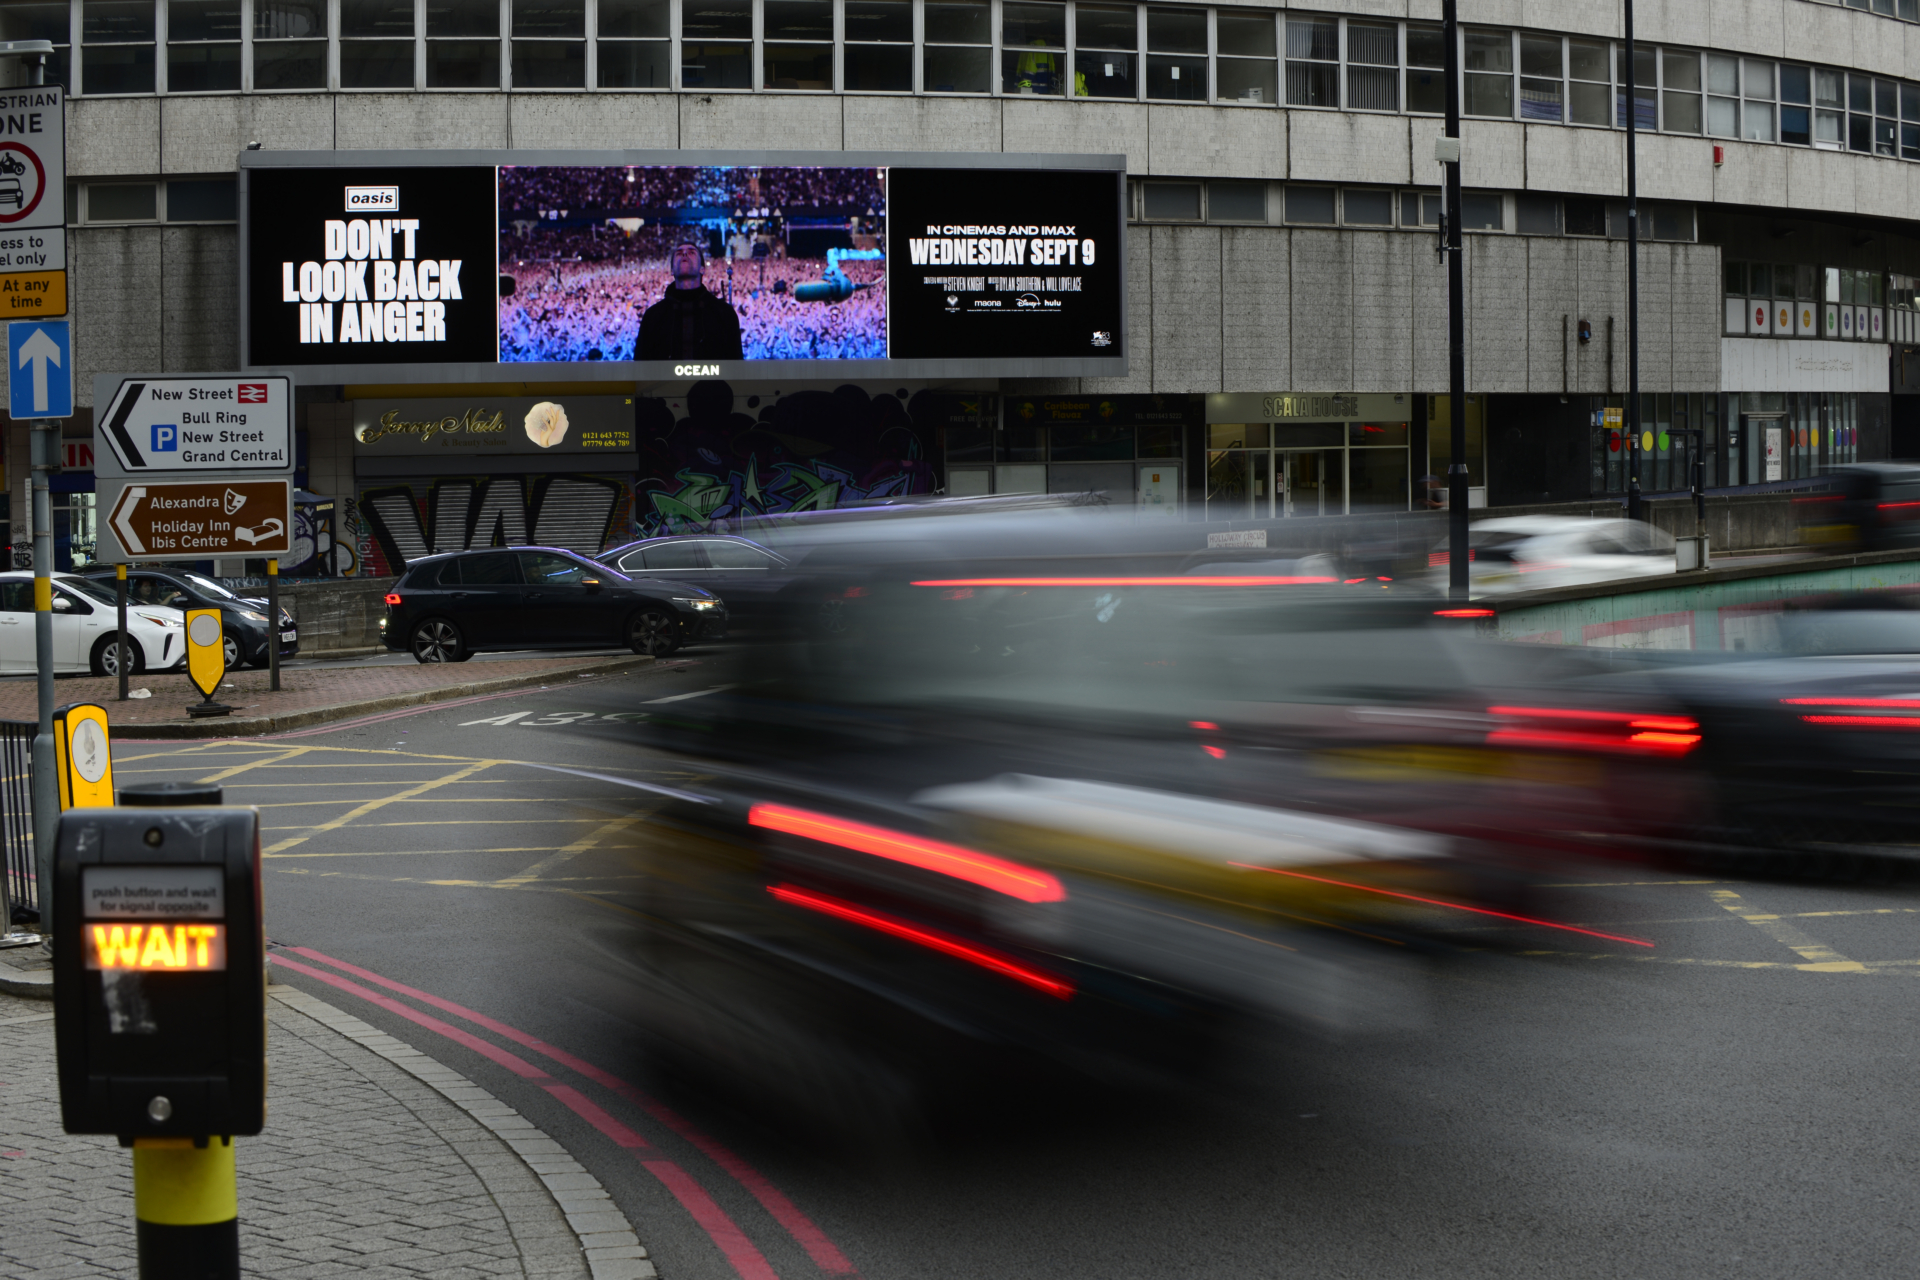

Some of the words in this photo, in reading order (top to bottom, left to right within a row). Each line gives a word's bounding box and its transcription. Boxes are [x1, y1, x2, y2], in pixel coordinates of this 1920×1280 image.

[0, 113, 43, 135] NE
[350, 190, 394, 206] oasis
[926, 225, 941, 236] IN
[943, 225, 1006, 236] CINEMAS
[1008, 225, 1039, 236] AND
[1041, 225, 1076, 236] IMAX
[29, 235, 44, 249] to
[324, 219, 420, 260] DON'T
[909, 238, 1027, 266] WEDNESDAY
[1030, 238, 1078, 266] SEPT
[1081, 238, 1096, 266] 9
[16, 251, 47, 269] only
[2, 279, 23, 293] At
[24, 280, 50, 295] any
[282, 260, 369, 302] LOOK
[373, 259, 463, 301] BACK
[10, 295, 43, 309] time
[1044, 299, 1062, 307] hulu
[300, 303, 333, 343] IN
[339, 301, 446, 343] ANGER
[674, 365, 720, 377] OCEAN
[151, 389, 183, 401] New
[188, 387, 233, 400] Street
[1044, 401, 1090, 411] Caribbean
[1263, 396, 1309, 418] SCALA
[1312, 396, 1359, 418] HOUSE
[183, 411, 210, 424] Bull
[215, 411, 247, 426] Ring
[949, 415, 966, 423] FREE
[1052, 410, 1082, 419] Flavaz
[361, 408, 441, 445] Jenny
[440, 407, 507, 435] Nails
[156, 427, 174, 450] P
[183, 431, 213, 443] New
[219, 430, 264, 442] Street
[582, 432, 598, 440] 0121
[599, 432, 612, 440] 643
[613, 431, 630, 439] 7752
[452, 438, 481, 449] Beauty
[483, 437, 507, 447] Salon
[582, 440, 603, 448] 07779
[604, 440, 617, 448] 656
[617, 440, 630, 448] 789
[183, 450, 225, 463] Grand
[230, 449, 283, 462] Central
[150, 496, 220, 510] Alexandra
[152, 521, 204, 535] Holiday
[209, 520, 231, 532] Inn
[151, 536, 176, 549] Ibis
[181, 535, 229, 548] Centre
[1209, 533, 1242, 543] HOLLOWAY
[1243, 532, 1265, 541] CIRCUS
[93, 886, 121, 899] push
[124, 886, 163, 898] button
[165, 887, 189, 898] and
[190, 886, 217, 898] wait
[100, 901, 116, 911] for
[119, 901, 155, 914] signal
[157, 901, 210, 914] opposite
[94, 927, 216, 966] WAIT
